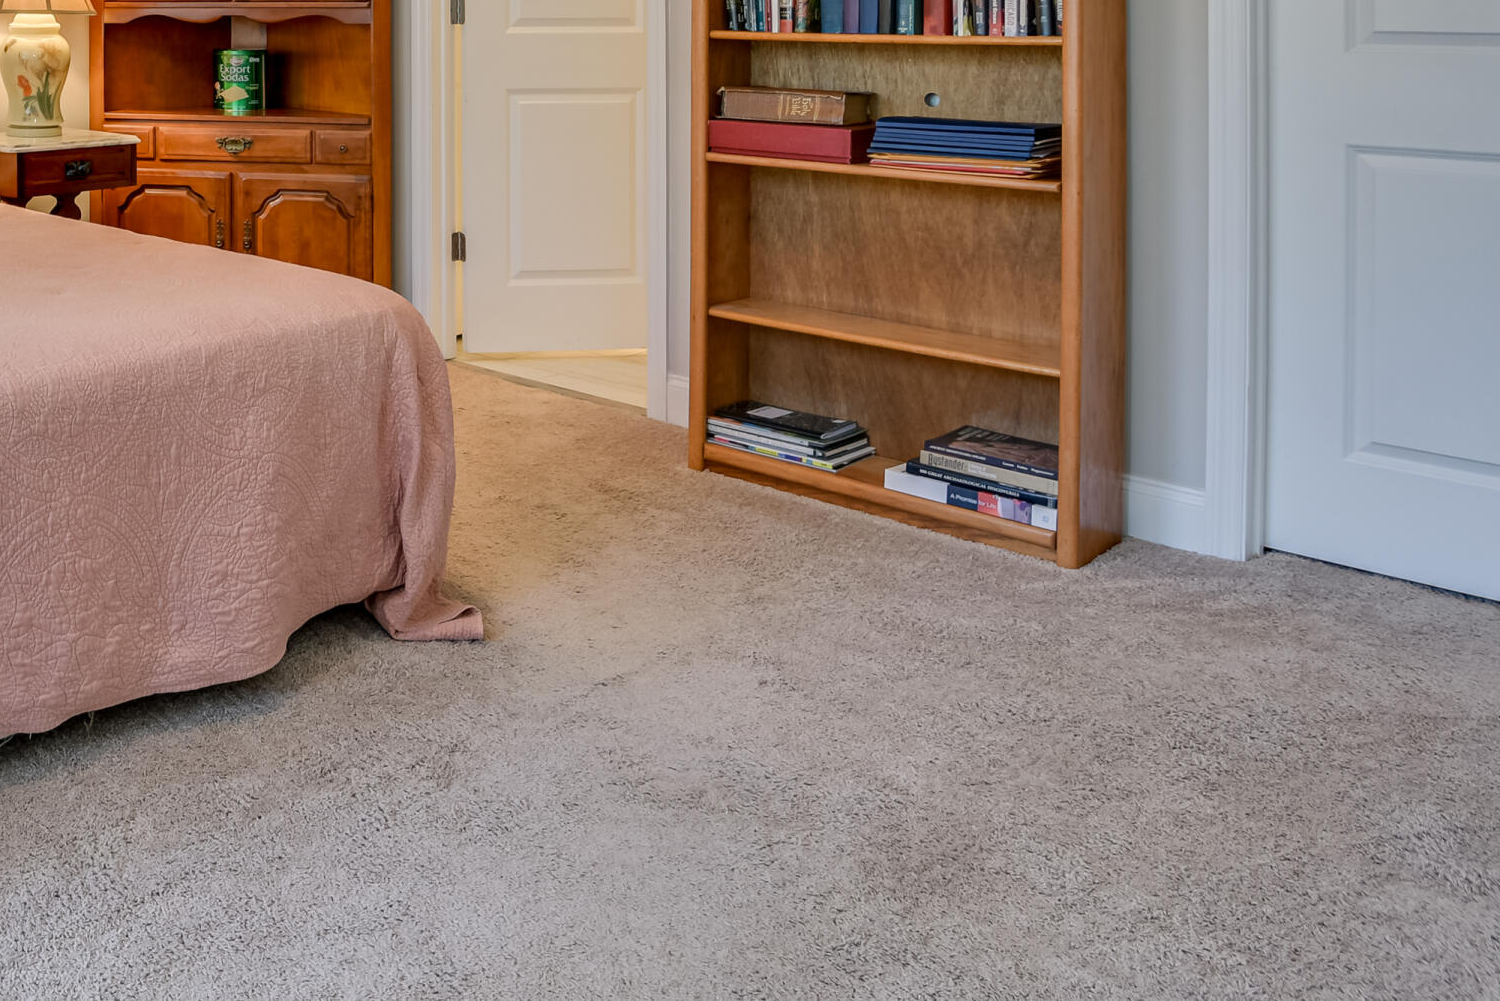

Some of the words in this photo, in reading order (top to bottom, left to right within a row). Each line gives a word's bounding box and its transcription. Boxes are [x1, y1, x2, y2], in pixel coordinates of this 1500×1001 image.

[220, 64, 251, 74] Export
[221, 73, 249, 82] Sodas
[790, 97, 802, 116] Bible
[800, 97, 811, 116] Holy
[928, 454, 964, 471] Bystander
[956, 494, 977, 505] Promise
